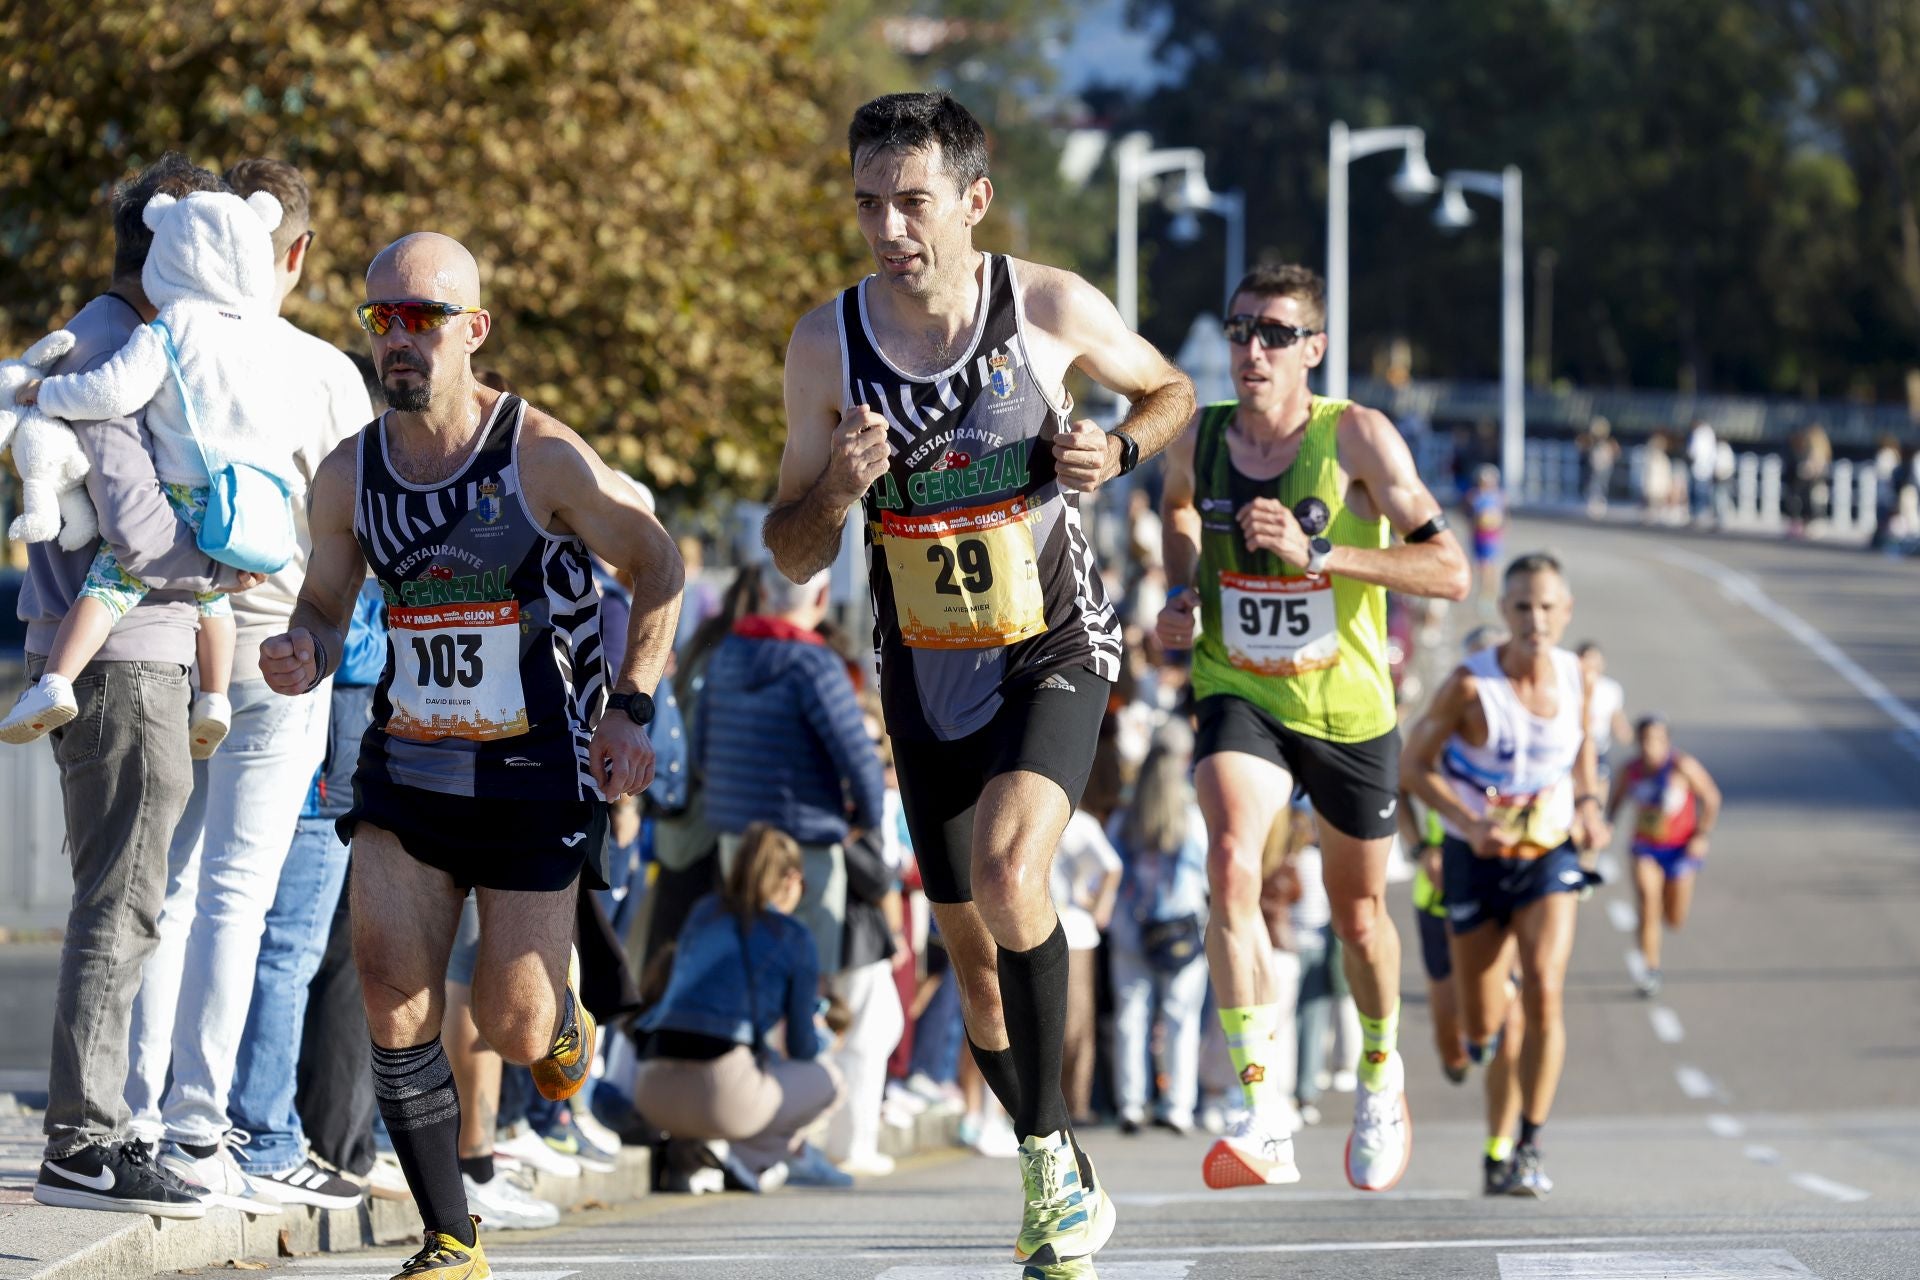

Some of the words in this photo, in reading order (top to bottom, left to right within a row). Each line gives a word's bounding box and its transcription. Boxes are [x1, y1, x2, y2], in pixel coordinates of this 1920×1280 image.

[905, 427, 1004, 468] RESTAURANTE
[872, 471, 904, 510] LA
[907, 440, 1030, 506] CEREZAL
[918, 520, 949, 533] MBA
[974, 509, 1006, 526] GIJÓN
[394, 544, 484, 577] RESTAURANTE
[926, 539, 993, 596] 29
[400, 564, 514, 608] CEREZAL
[413, 614, 443, 625] MBA
[463, 609, 495, 621] GIJÓN
[970, 604, 990, 612] MIER
[1239, 597, 1310, 638] 975
[411, 634, 484, 688] 103
